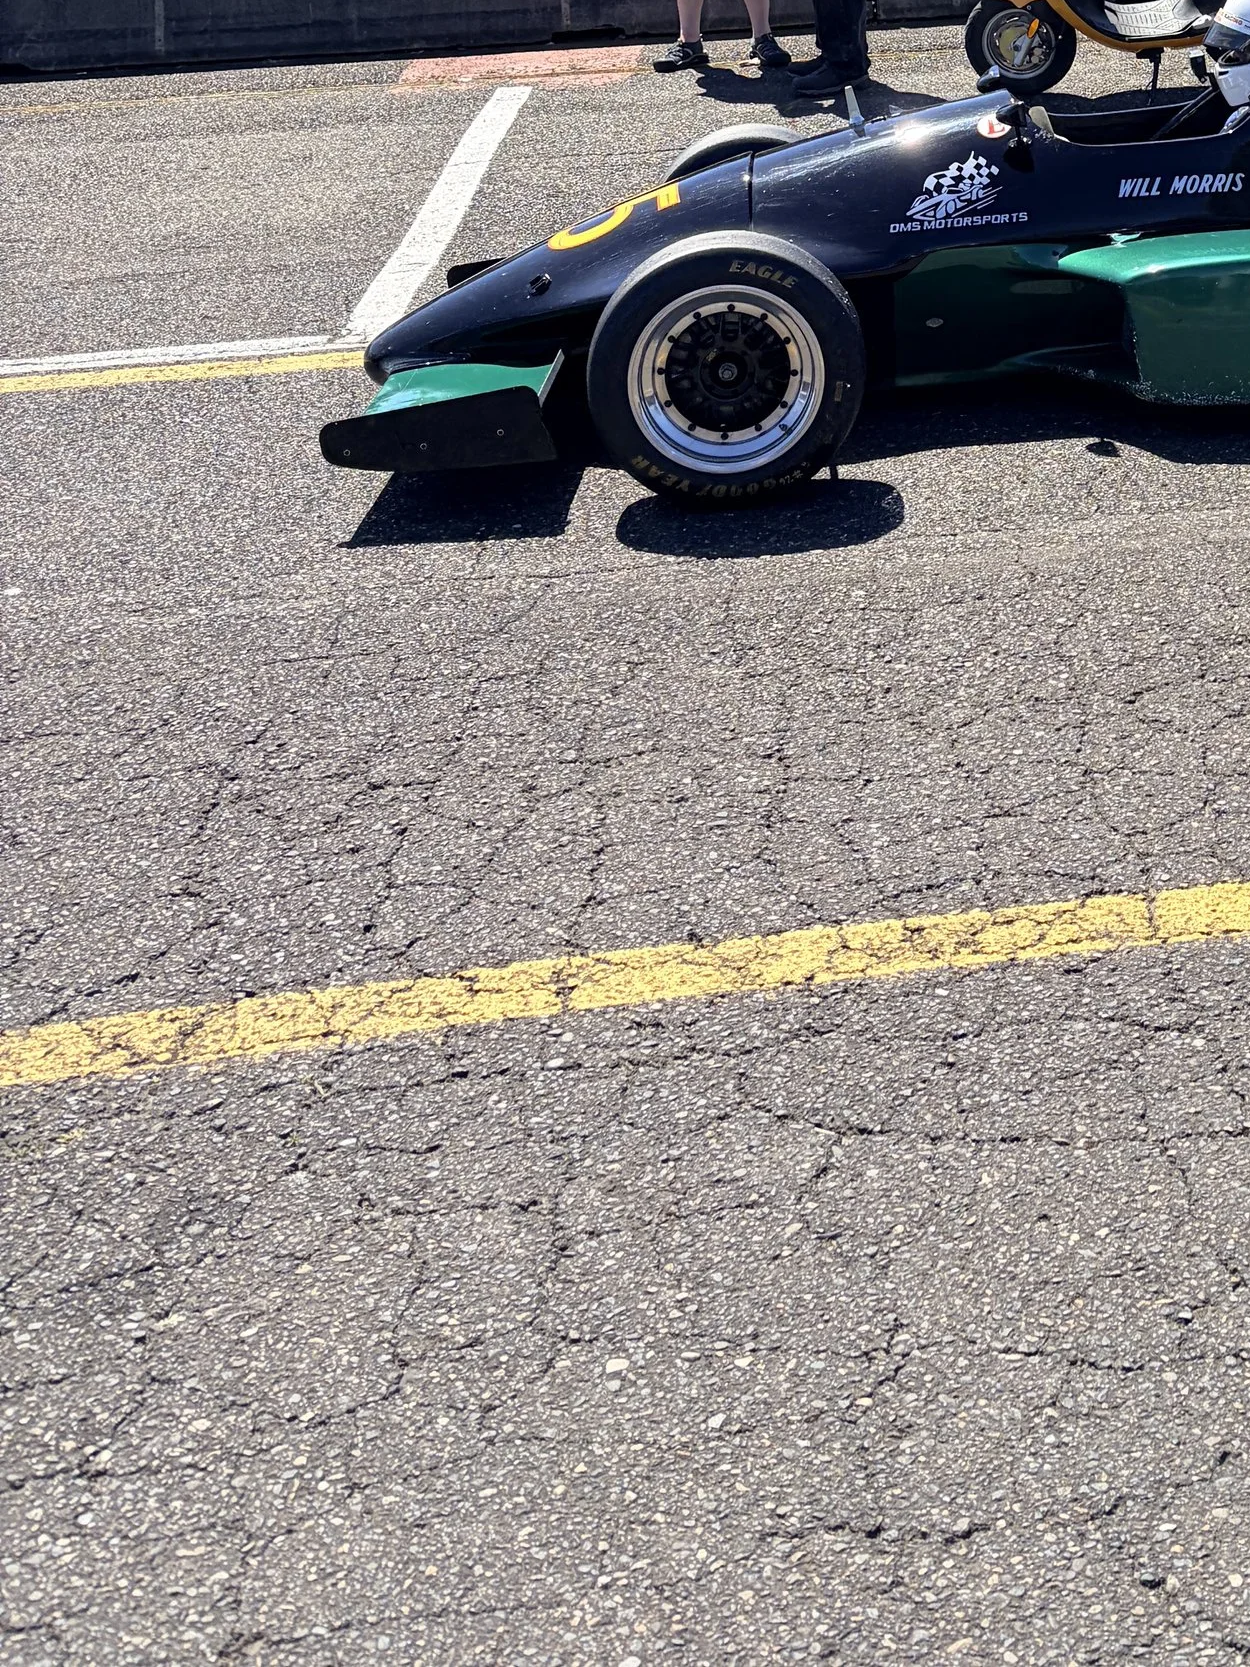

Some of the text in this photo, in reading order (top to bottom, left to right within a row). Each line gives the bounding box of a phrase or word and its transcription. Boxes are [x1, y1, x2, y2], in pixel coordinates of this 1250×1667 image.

[1118, 173, 1245, 198] WILL MORRIS
[889, 212, 1029, 234] DMS MOTORSPORTS
[728, 260, 799, 289] EAGLE
